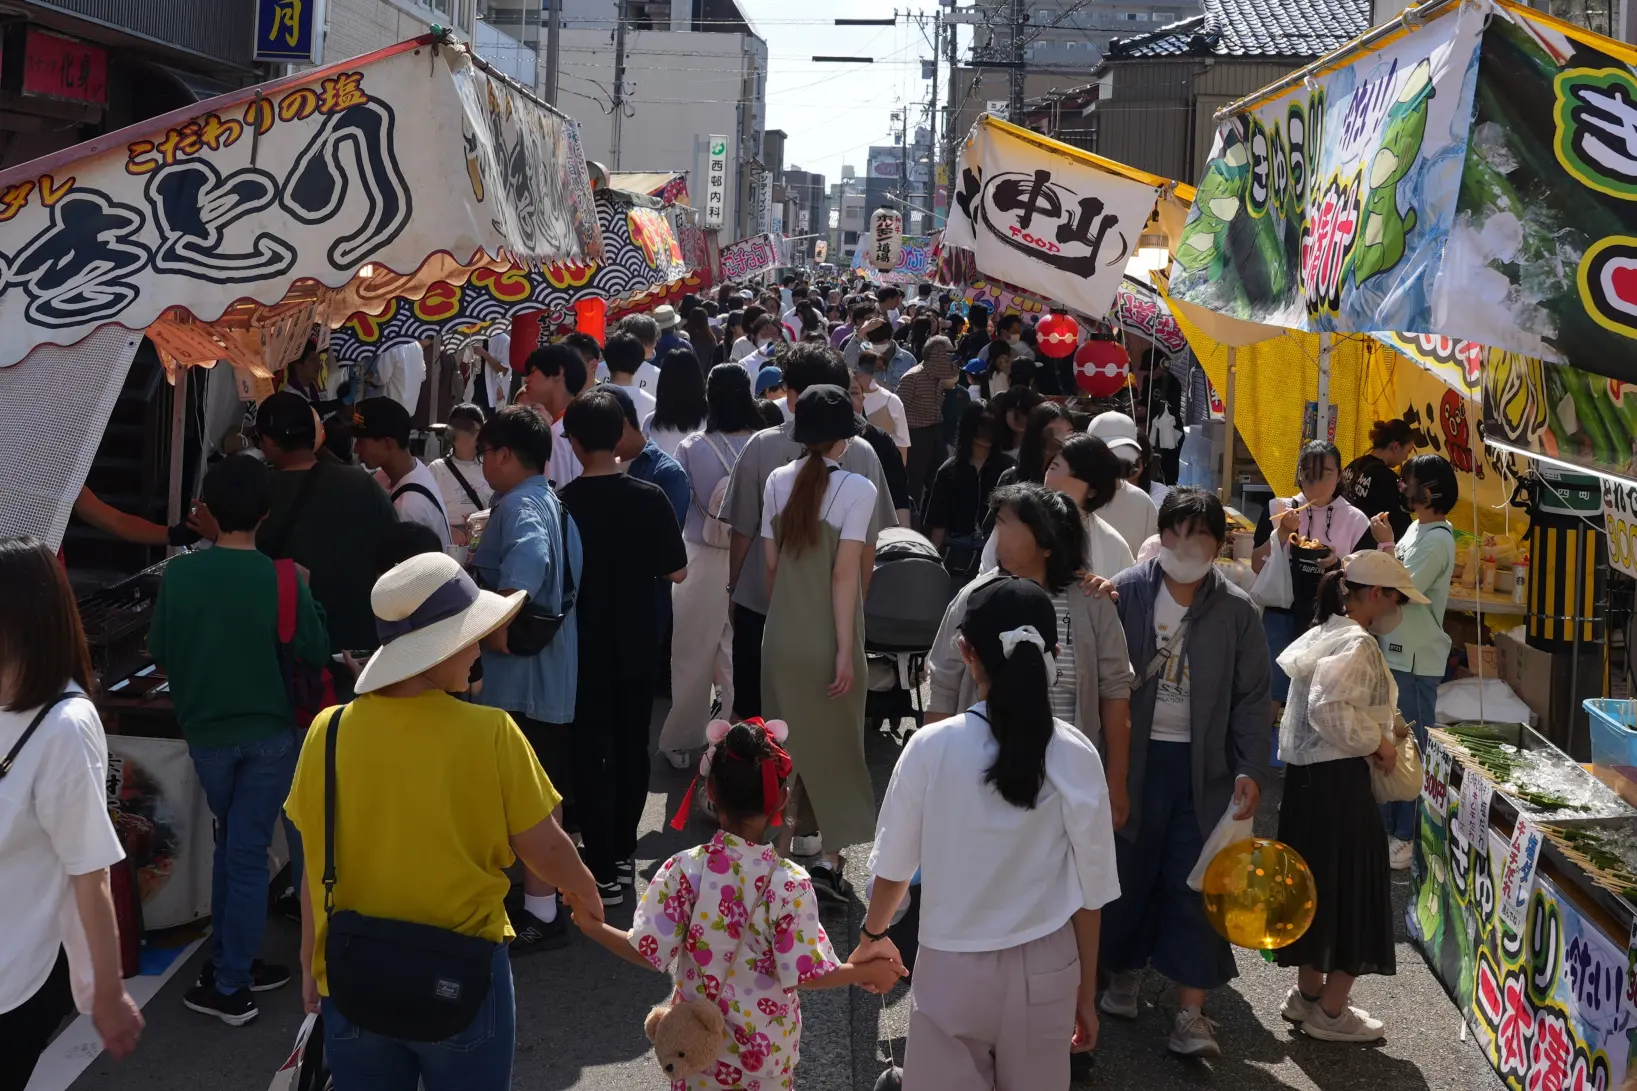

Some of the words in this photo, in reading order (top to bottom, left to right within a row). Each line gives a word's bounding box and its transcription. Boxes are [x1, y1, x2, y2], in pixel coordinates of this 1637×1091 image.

[269, 0, 302, 47] 月
[126, 72, 368, 175] こだわりの塩
[1248, 87, 1326, 217] きゅうり
[0, 94, 412, 329] きとり
[758, 175, 768, 233] シティイン富山
[992, 170, 1119, 279] 中山
[876, 214, 894, 262] ホルモン道場
[1009, 225, 1060, 253] FOOD
[1117, 291, 1184, 351] 道場
[1424, 772, 1446, 809] 300円
[1468, 791, 1478, 841] キムチだれ
[1502, 820, 1526, 899] キムチだれ
[1451, 817, 1557, 996] きゅり
